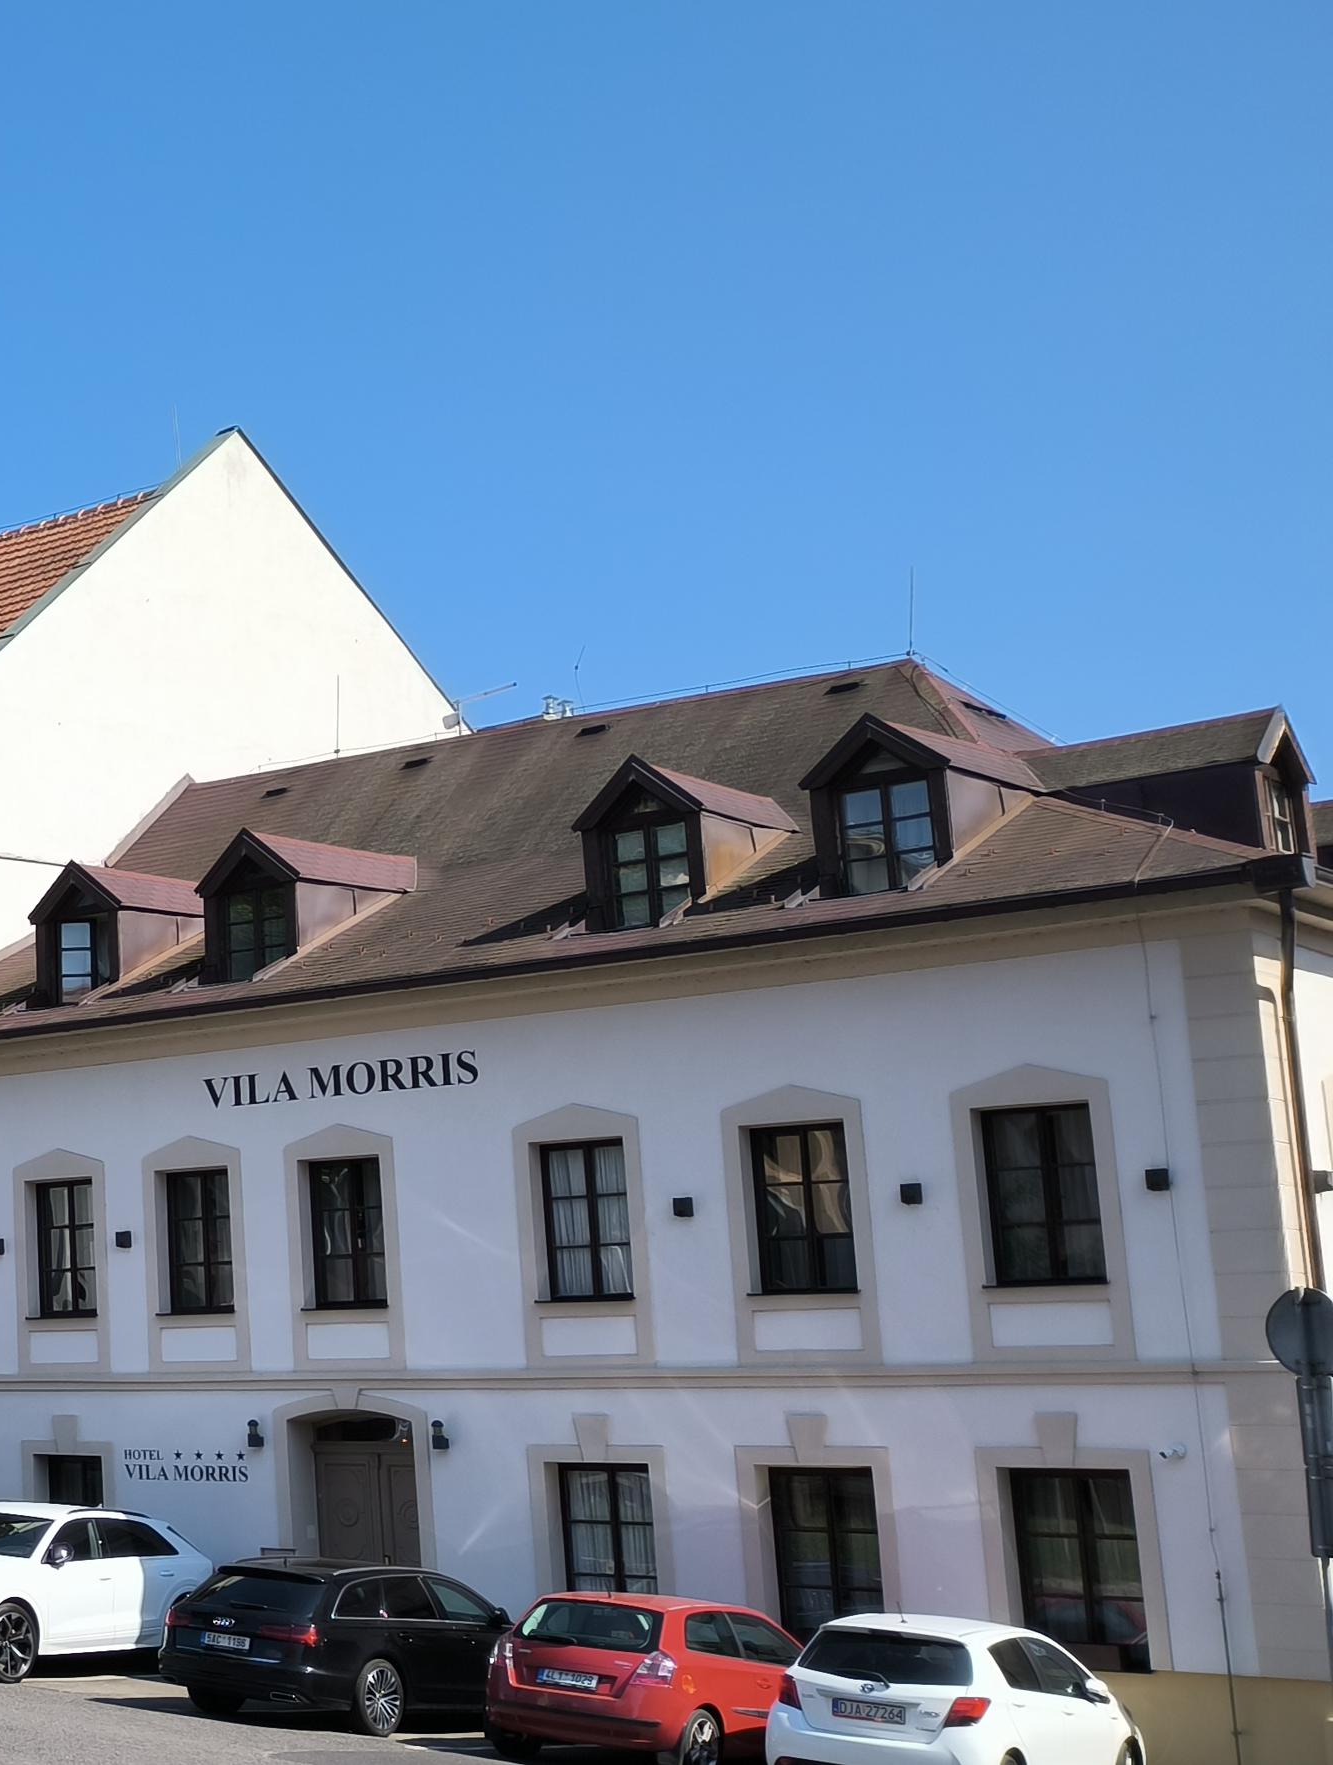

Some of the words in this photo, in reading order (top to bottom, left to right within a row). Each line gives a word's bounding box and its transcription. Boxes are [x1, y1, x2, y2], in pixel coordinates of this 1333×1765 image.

[202, 1070, 300, 1109] VILA
[306, 1049, 480, 1099] MORRIS
[124, 1449, 164, 1460] HOTEL
[124, 1463, 169, 1481] VILA
[173, 1464, 249, 1482] MORRIS
[839, 1702, 863, 1716] DJA
[865, 1704, 903, 1721] 27264
